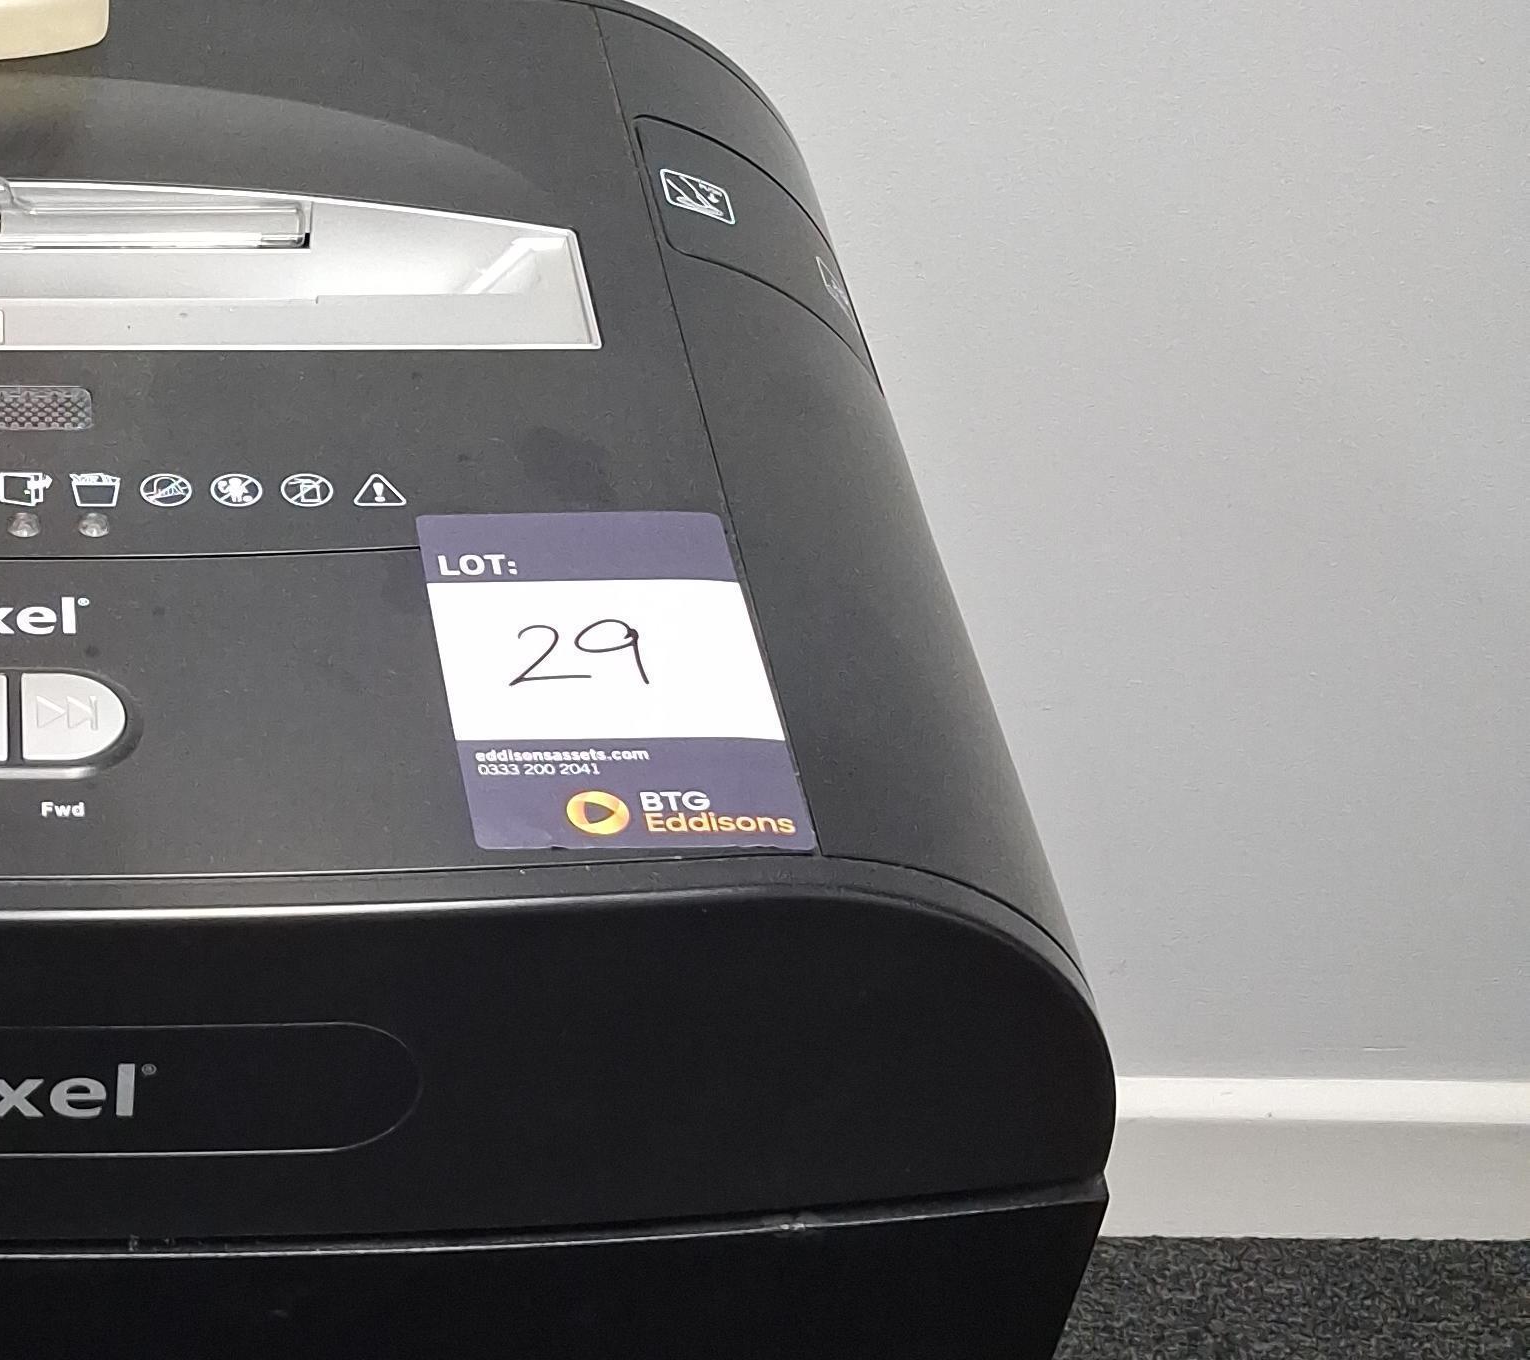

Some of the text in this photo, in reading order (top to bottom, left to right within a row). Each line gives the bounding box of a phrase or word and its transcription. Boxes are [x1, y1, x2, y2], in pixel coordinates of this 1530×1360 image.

[437, 554, 518, 576] LOT:
[509, 619, 649, 686] 29
[475, 749, 650, 762] eddisonsassets.com
[477, 763, 601, 776] 0333 200 2041
[41, 801, 85, 818] Fwd
[639, 791, 711, 811] BTG
[643, 812, 797, 834] Eddisons
